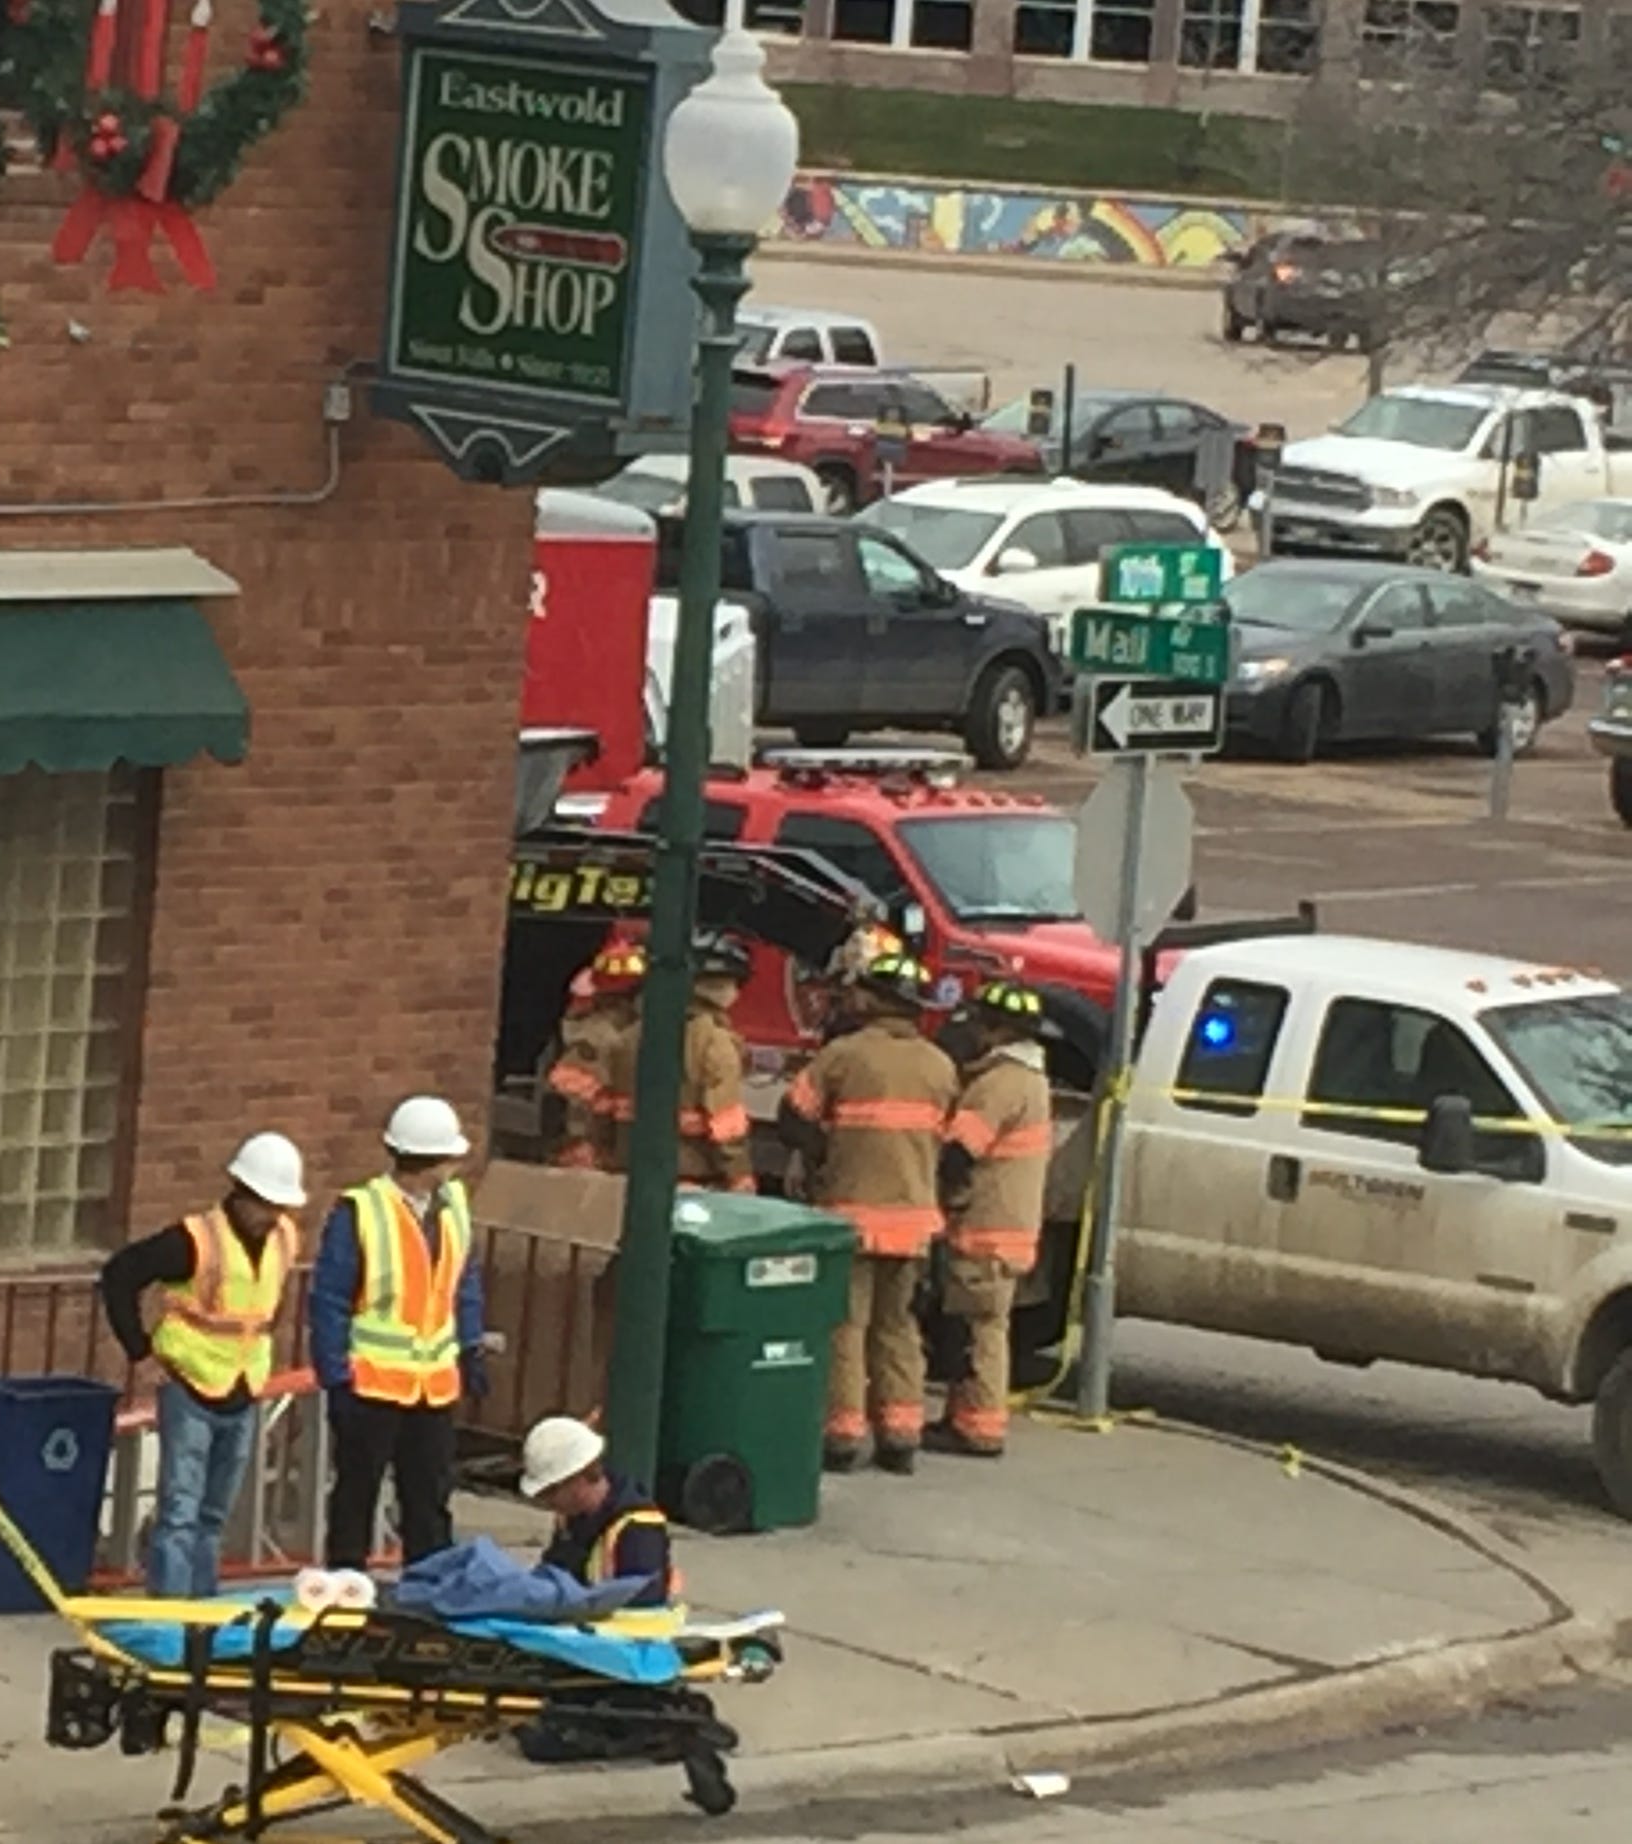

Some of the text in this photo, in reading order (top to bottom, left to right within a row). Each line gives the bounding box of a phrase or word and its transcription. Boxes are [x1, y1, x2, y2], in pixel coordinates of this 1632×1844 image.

[440, 70, 625, 127] Eastwold
[413, 132, 614, 261] SMOKE
[459, 206, 616, 336] SHOP
[1084, 618, 1151, 665] Mall
